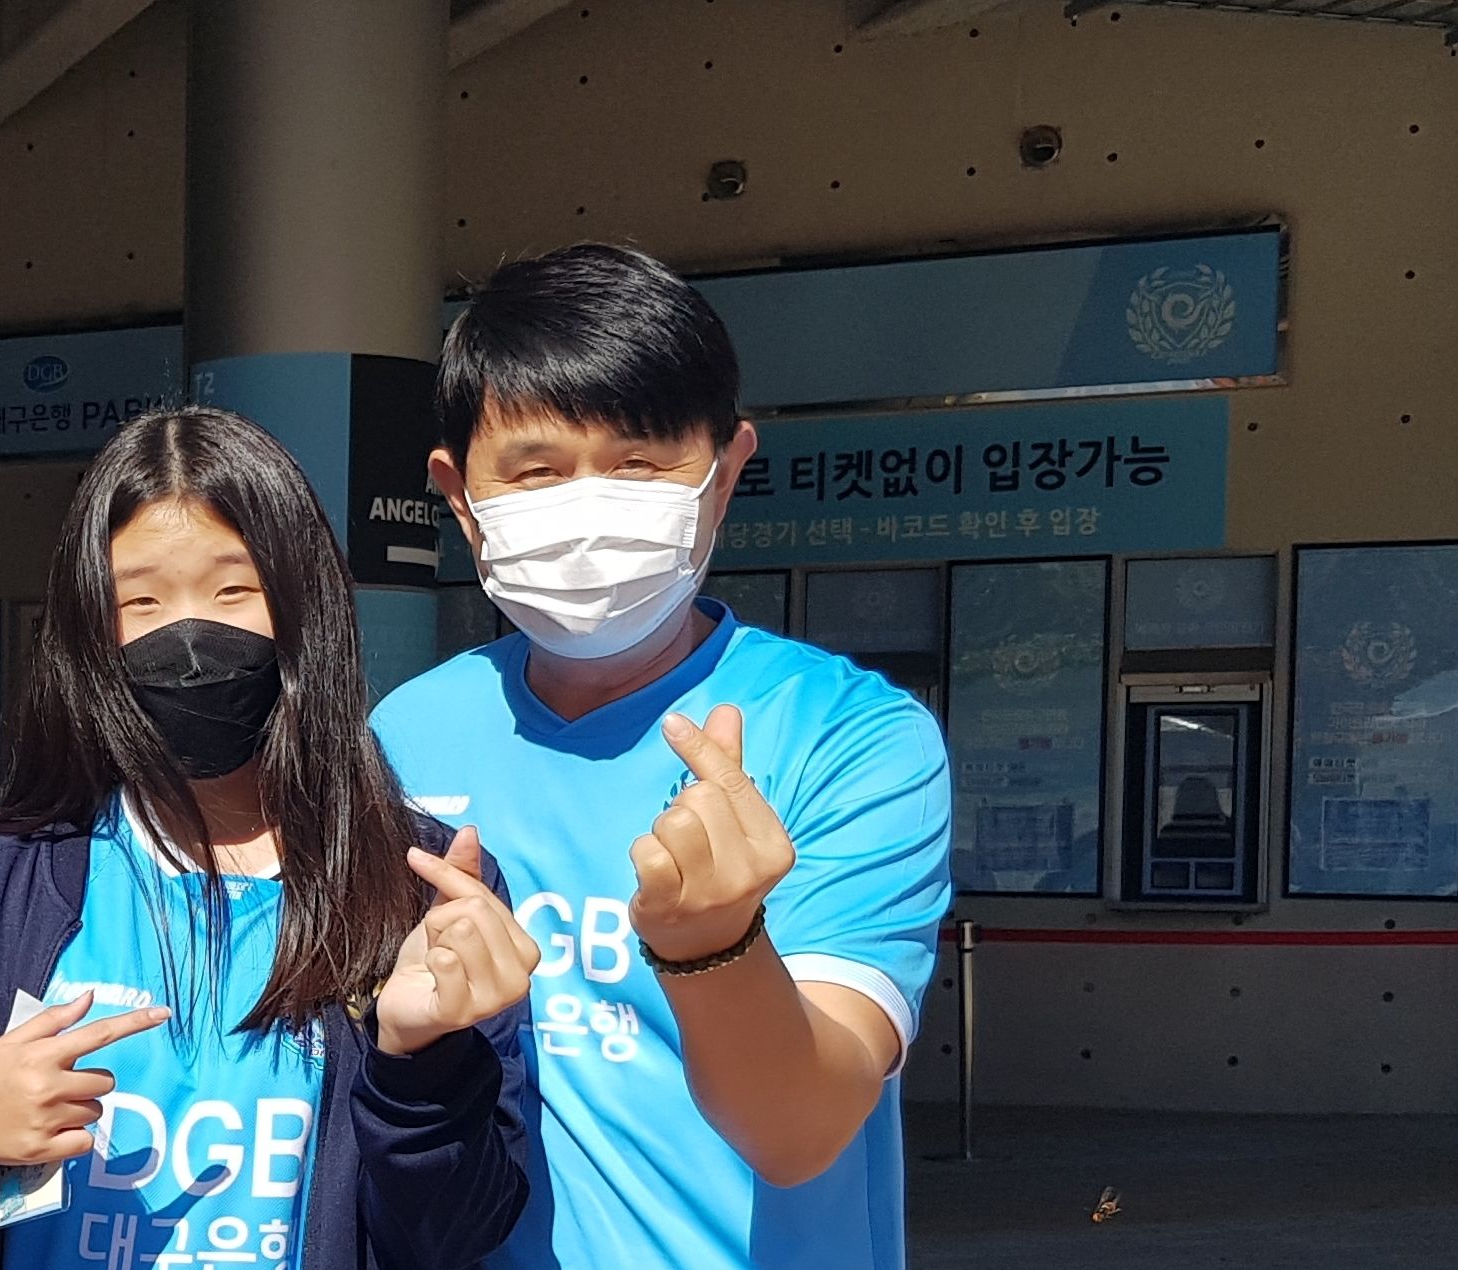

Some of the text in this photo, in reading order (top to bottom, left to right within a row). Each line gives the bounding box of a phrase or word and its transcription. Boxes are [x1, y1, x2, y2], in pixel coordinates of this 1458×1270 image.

[28, 362, 63, 382] DGB
[734, 436, 1170, 502] 로 티켓없이 입장가능
[369, 496, 431, 526] ANGEL
[807, 515, 854, 546] 선택
[876, 511, 952, 542] 바코드
[958, 509, 1007, 540] 확인
[1015, 508, 1042, 537] 후
[1049, 506, 1101, 536] 입장
[514, 891, 633, 984] GB
[522, 993, 641, 1063] 은행
[87, 1090, 312, 1198] DGB
